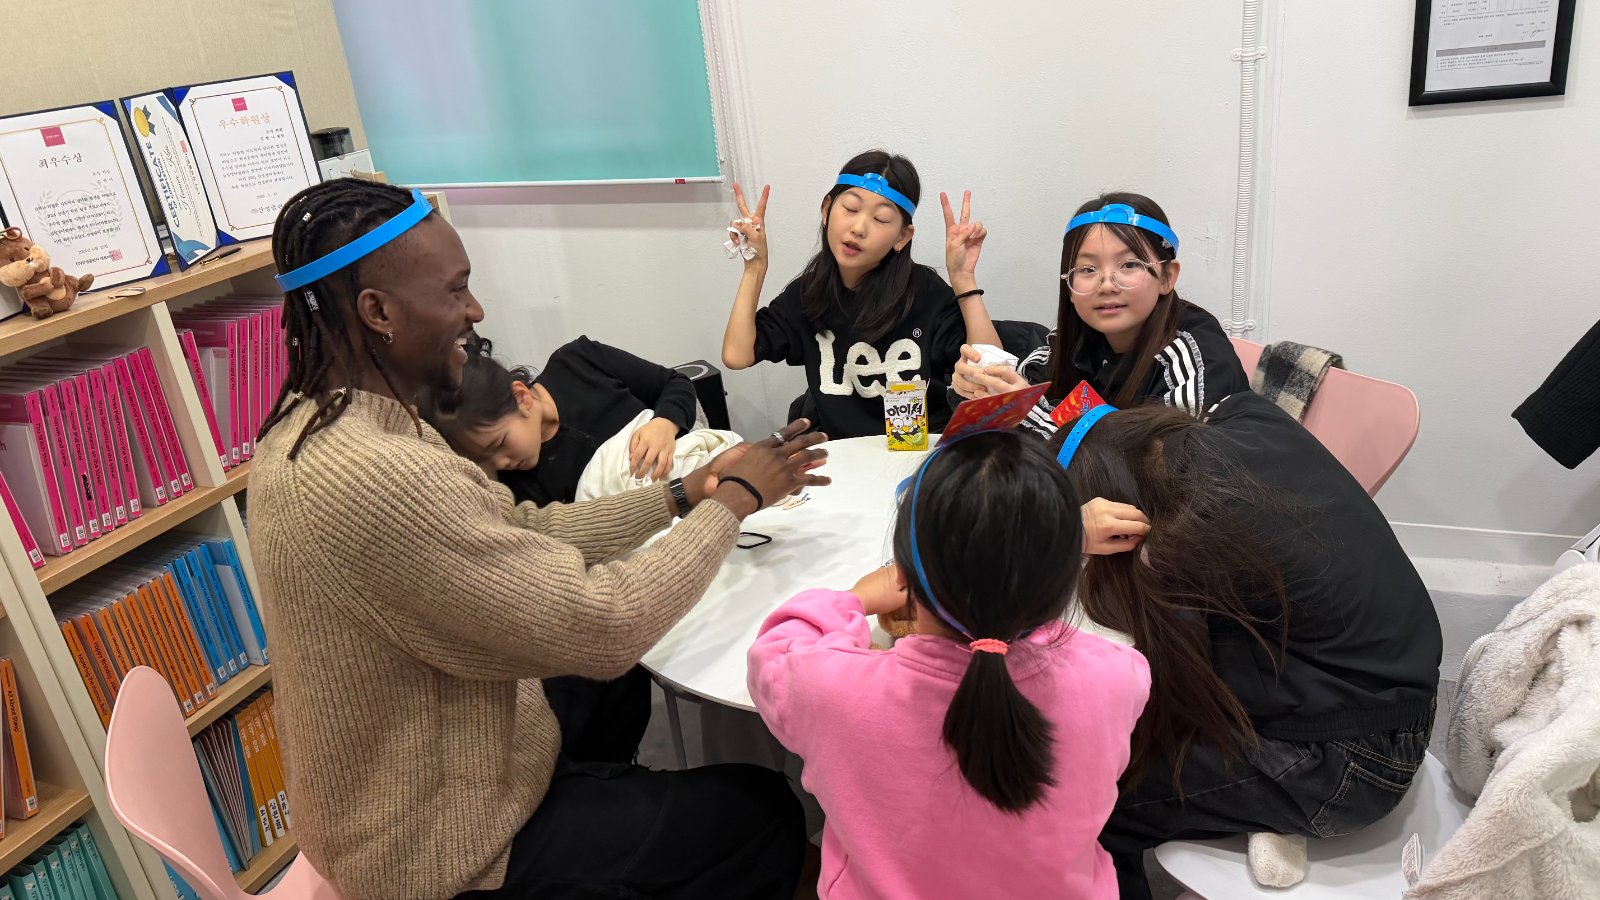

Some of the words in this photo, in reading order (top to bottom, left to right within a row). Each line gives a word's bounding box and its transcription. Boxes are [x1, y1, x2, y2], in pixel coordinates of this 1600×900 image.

[218, 112, 271, 130] 우수학원상
[39, 152, 82, 168] 최우수상
[146, 141, 179, 228] CERTIFICATE
[815, 330, 922, 398] Lee
[886, 403, 923, 417] 아이셔
